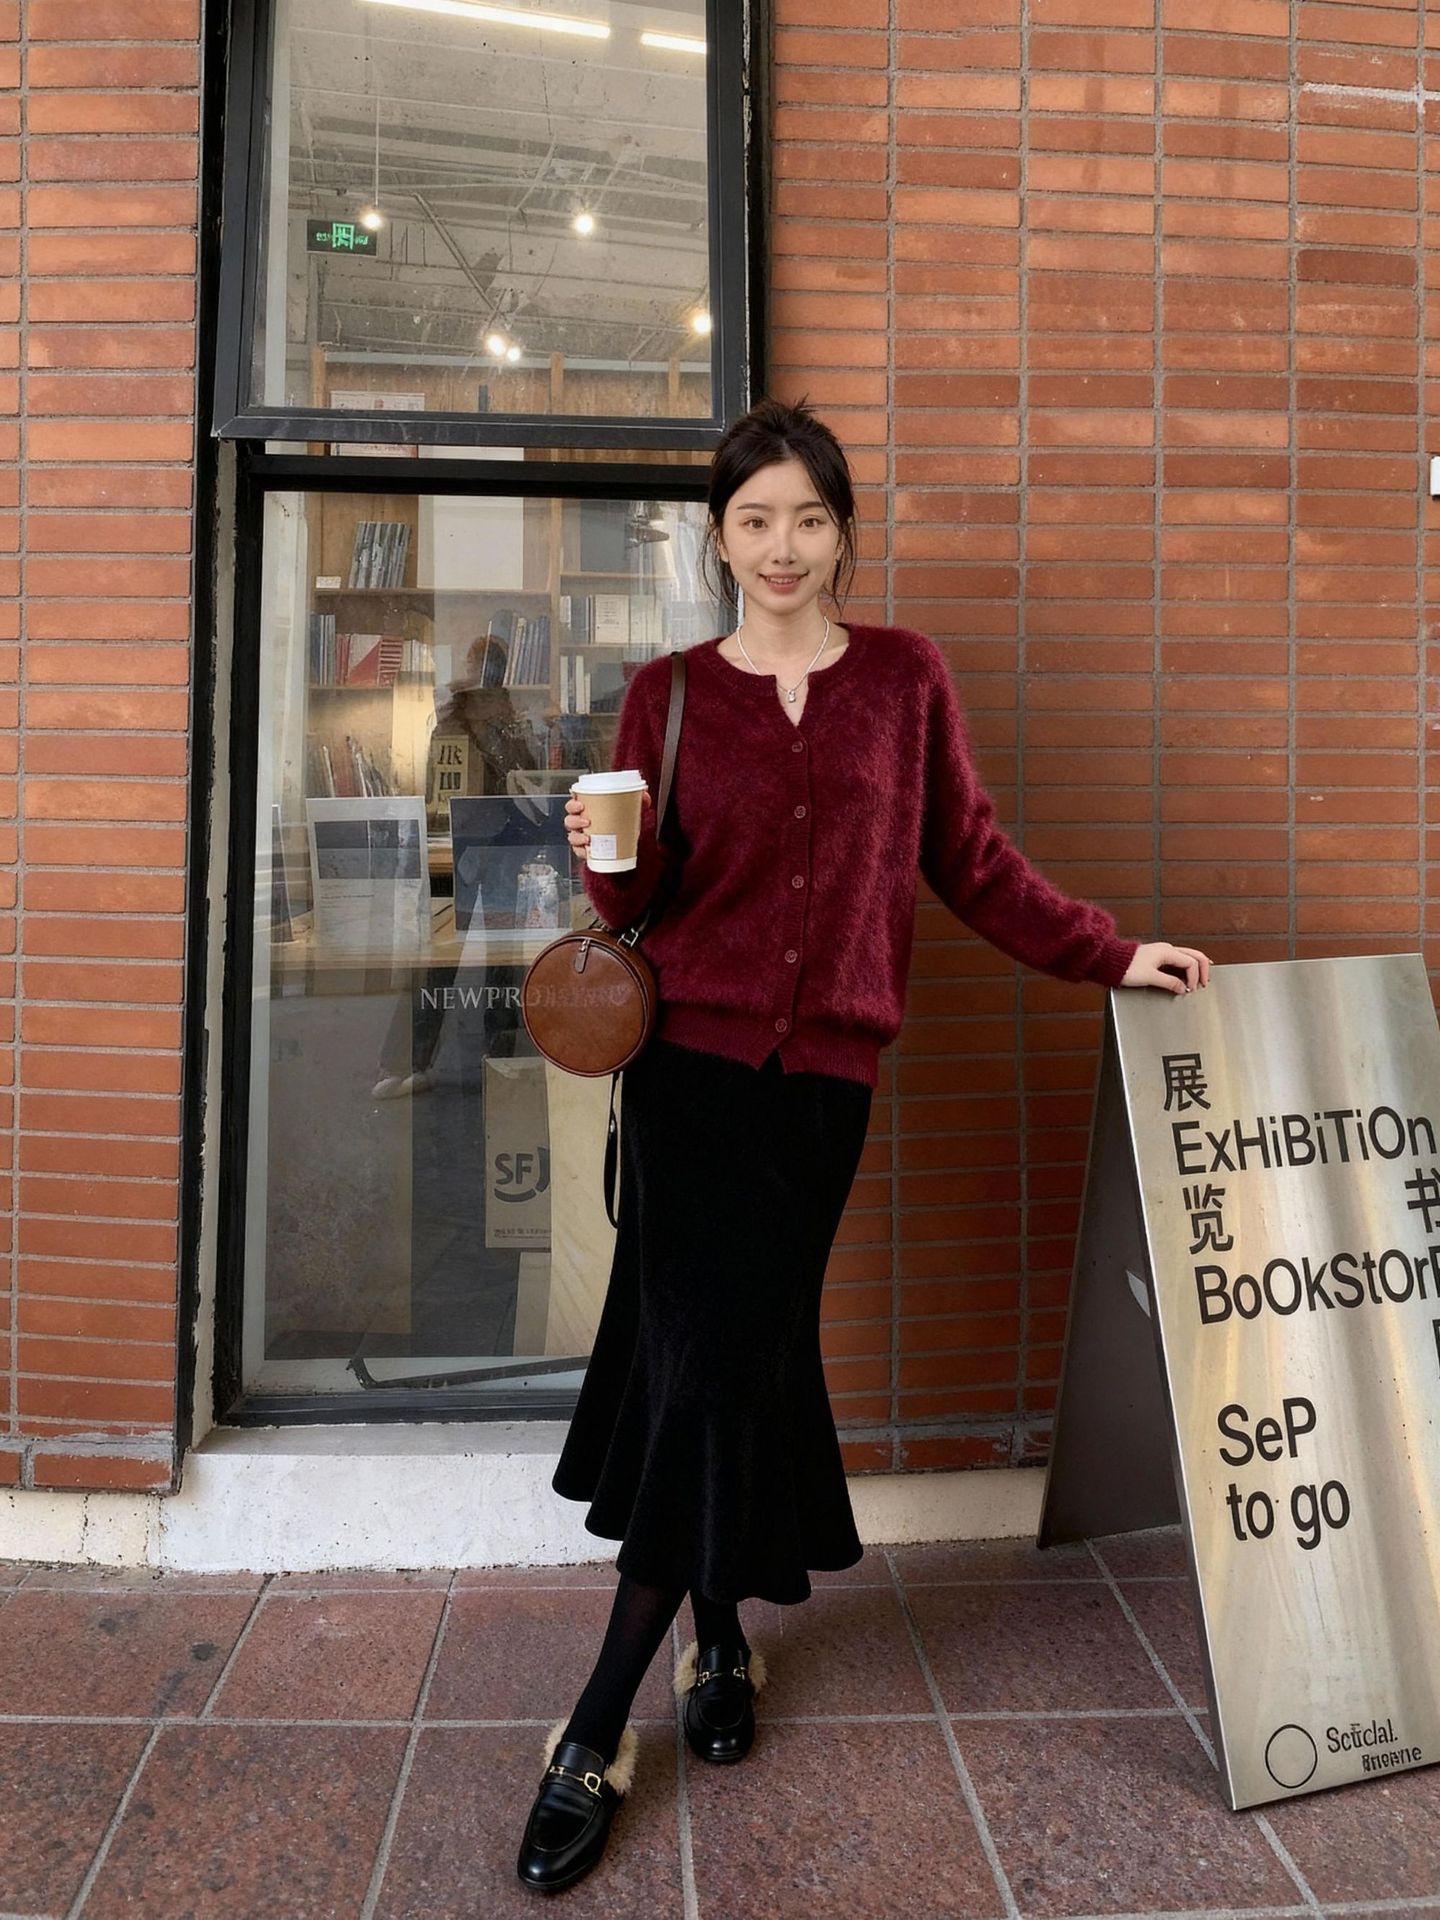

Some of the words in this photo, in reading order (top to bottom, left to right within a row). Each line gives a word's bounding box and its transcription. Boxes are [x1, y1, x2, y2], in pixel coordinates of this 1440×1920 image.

[1162, 1053, 1211, 1112] 展
[494, 1153, 533, 1185] SF
[1182, 1183, 1234, 1254] 览
[1217, 1397, 1316, 1466] SeP
[1226, 1483, 1274, 1541] to
[1290, 1480, 1350, 1550] go
